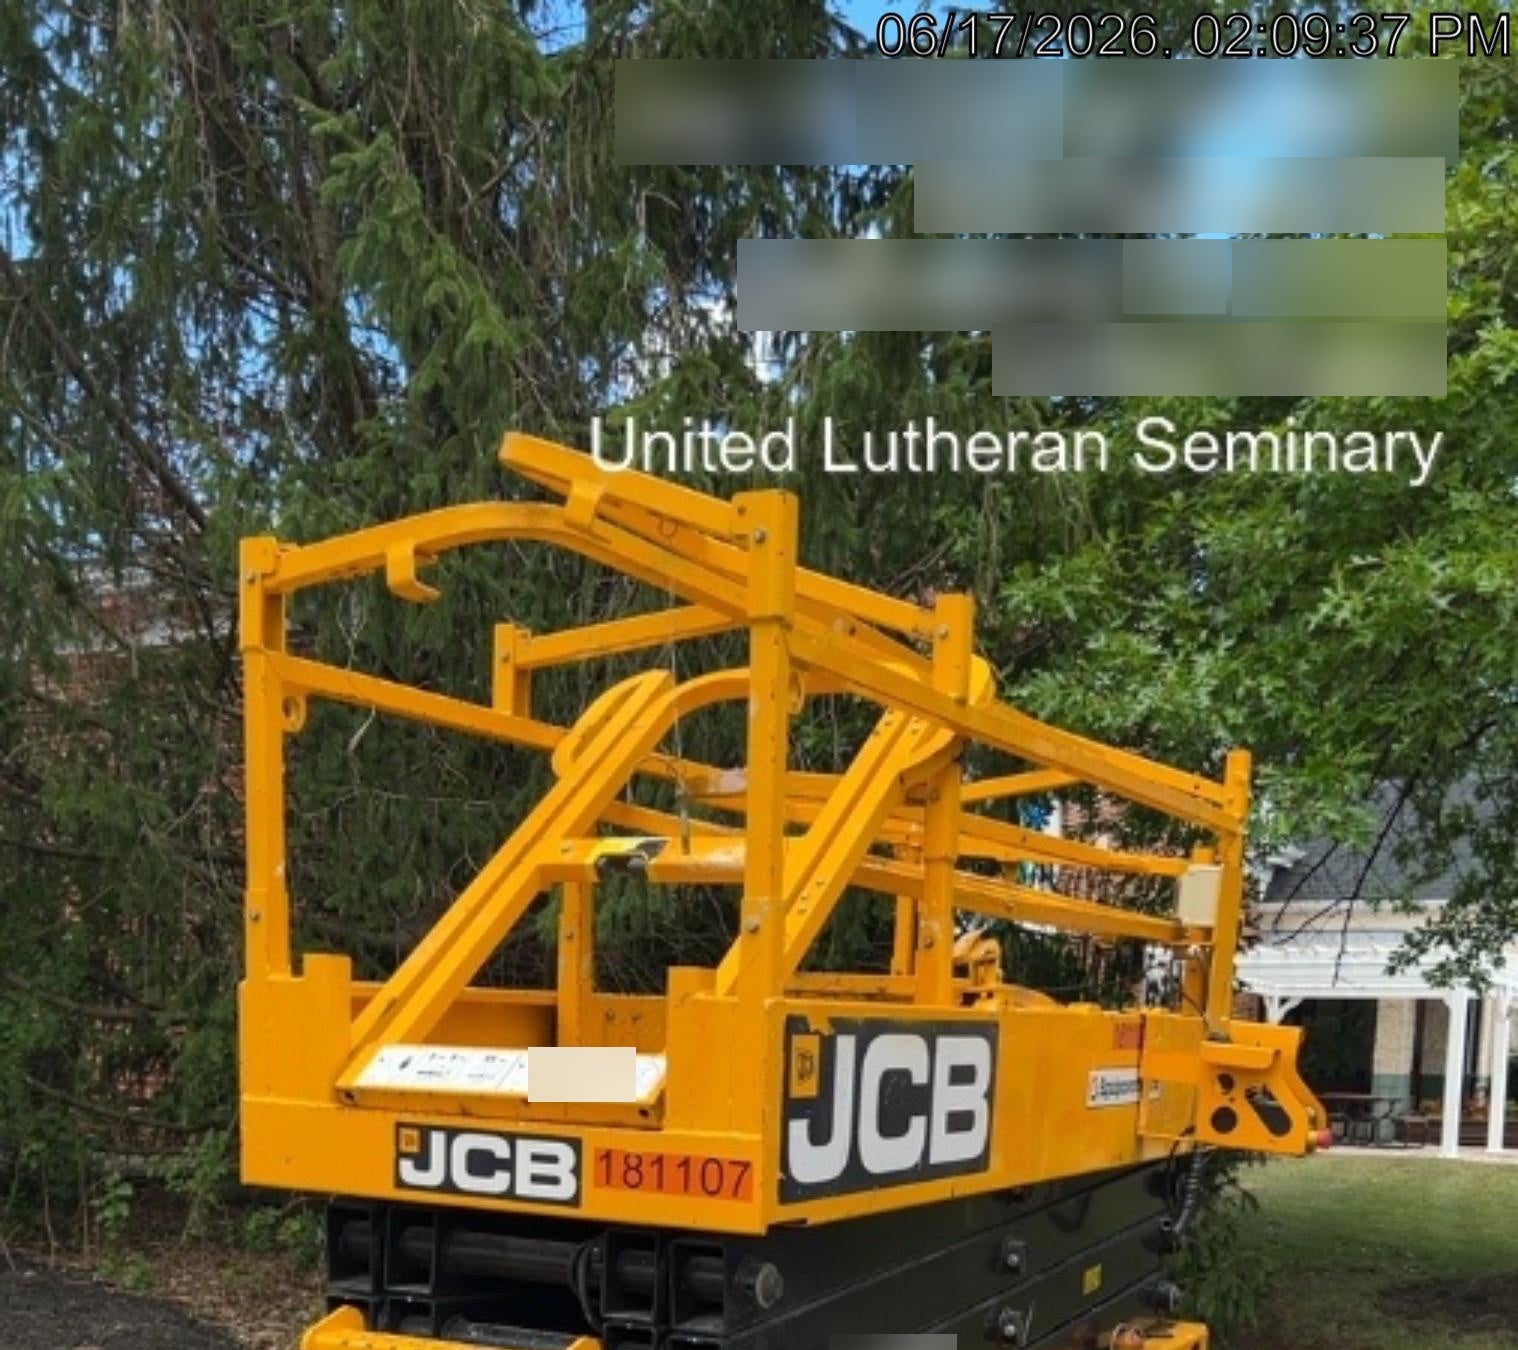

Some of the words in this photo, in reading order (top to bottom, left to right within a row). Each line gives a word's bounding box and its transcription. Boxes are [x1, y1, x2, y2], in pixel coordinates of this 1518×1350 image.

[788, 1034, 991, 1183] JCB
[399, 1130, 577, 1200] JCB
[598, 1148, 752, 1198] 181107
